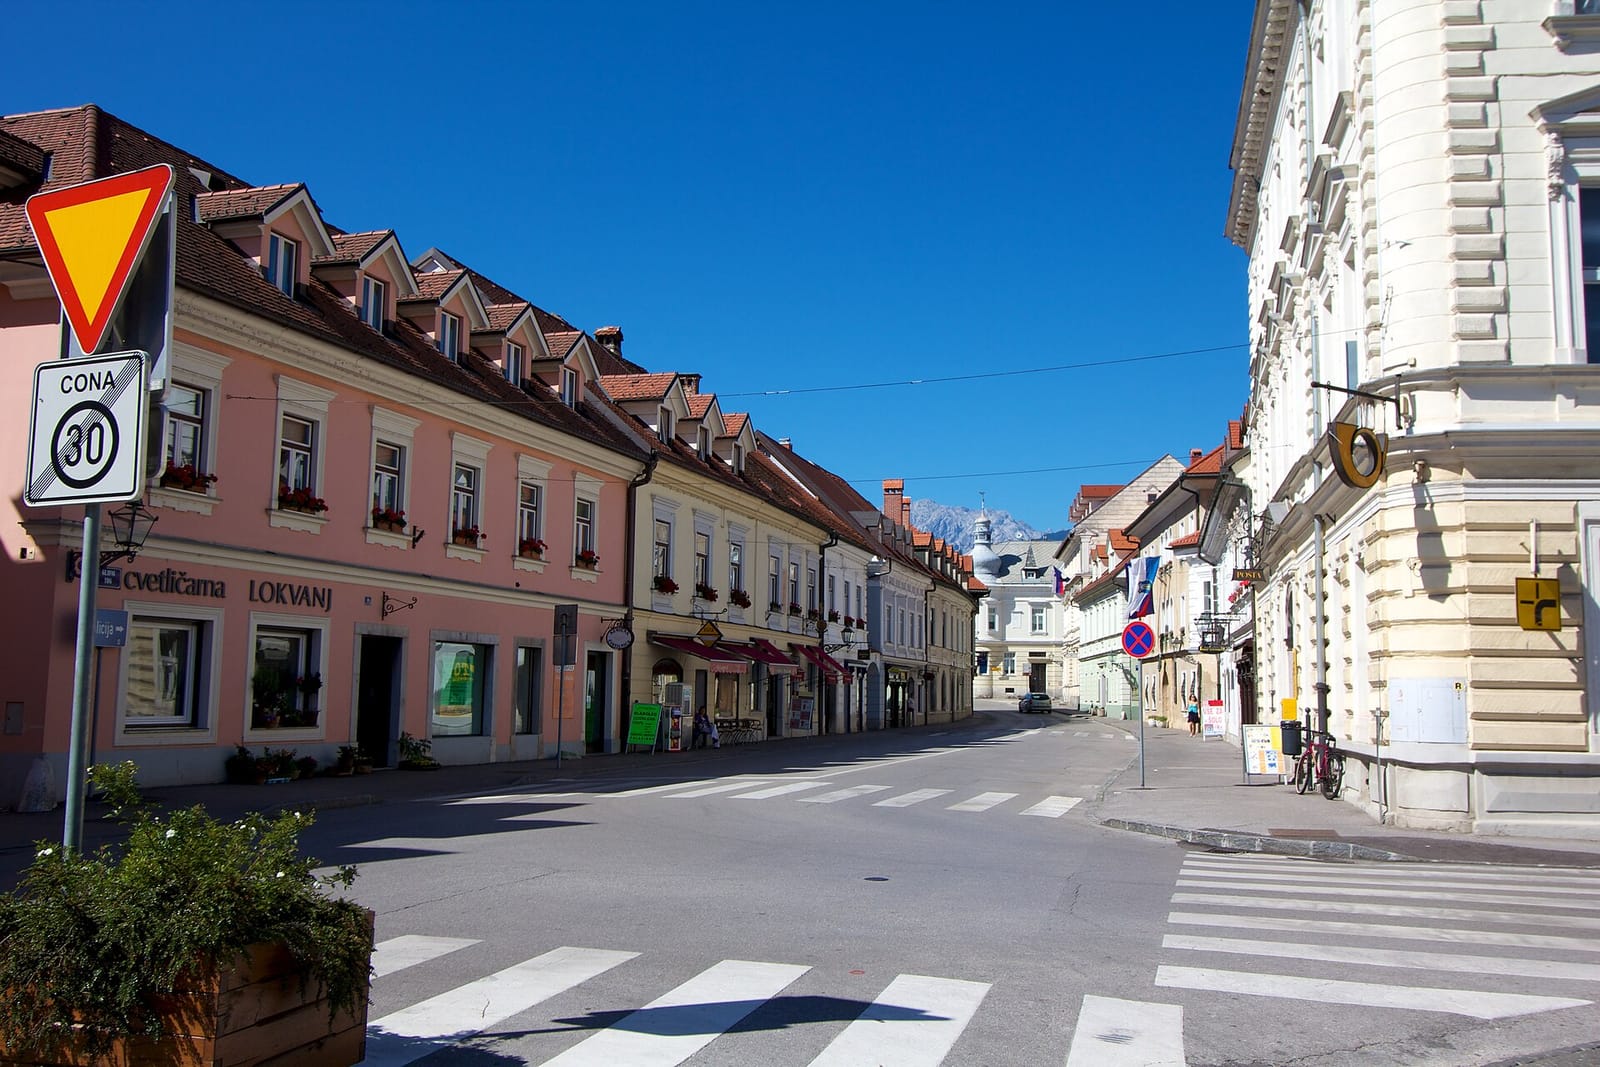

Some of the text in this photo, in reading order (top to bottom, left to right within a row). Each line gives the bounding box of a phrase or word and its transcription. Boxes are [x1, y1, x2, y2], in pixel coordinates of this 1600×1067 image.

[61, 370, 117, 394] CONA
[65, 423, 104, 467] 30
[124, 568, 332, 613] cvetličarna LOKVANJ
[96, 620, 114, 639] licija
